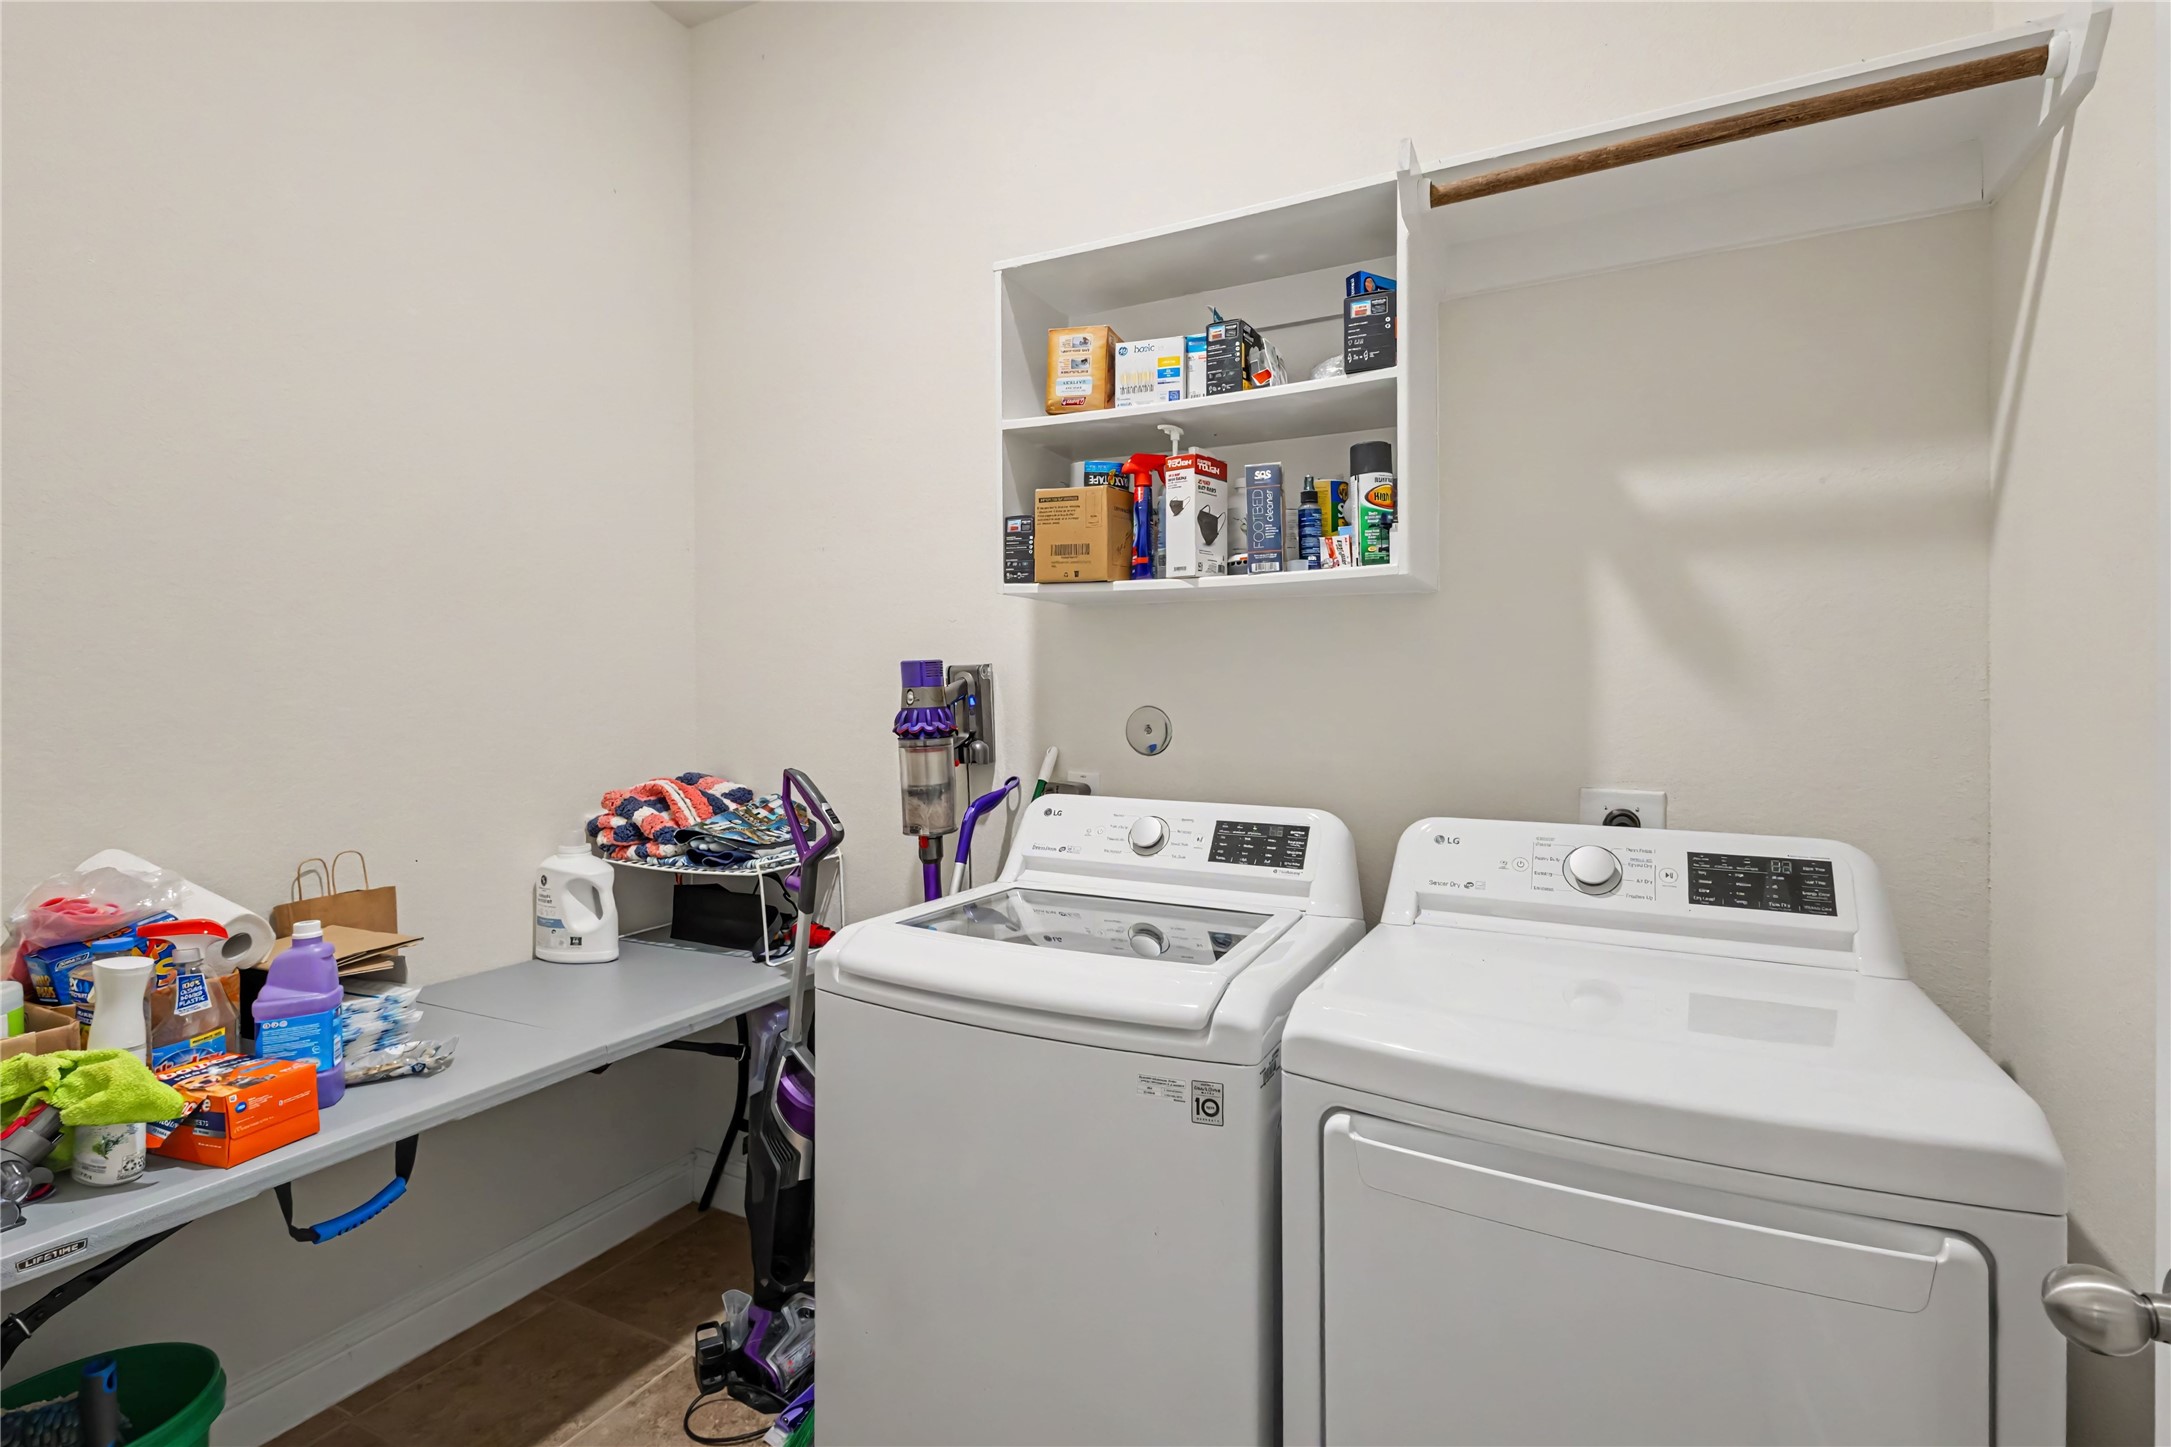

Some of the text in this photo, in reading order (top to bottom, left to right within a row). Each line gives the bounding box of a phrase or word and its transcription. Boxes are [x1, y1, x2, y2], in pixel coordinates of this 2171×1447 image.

[1088, 475, 1108, 485] TAPE
[1264, 490, 1274, 522] cleaner
[1252, 489, 1265, 549] FOOTBED
[1447, 837, 1460, 845] LG
[1195, 1097, 1220, 1117] 10
[24, 1243, 79, 1268] LIFETIME
